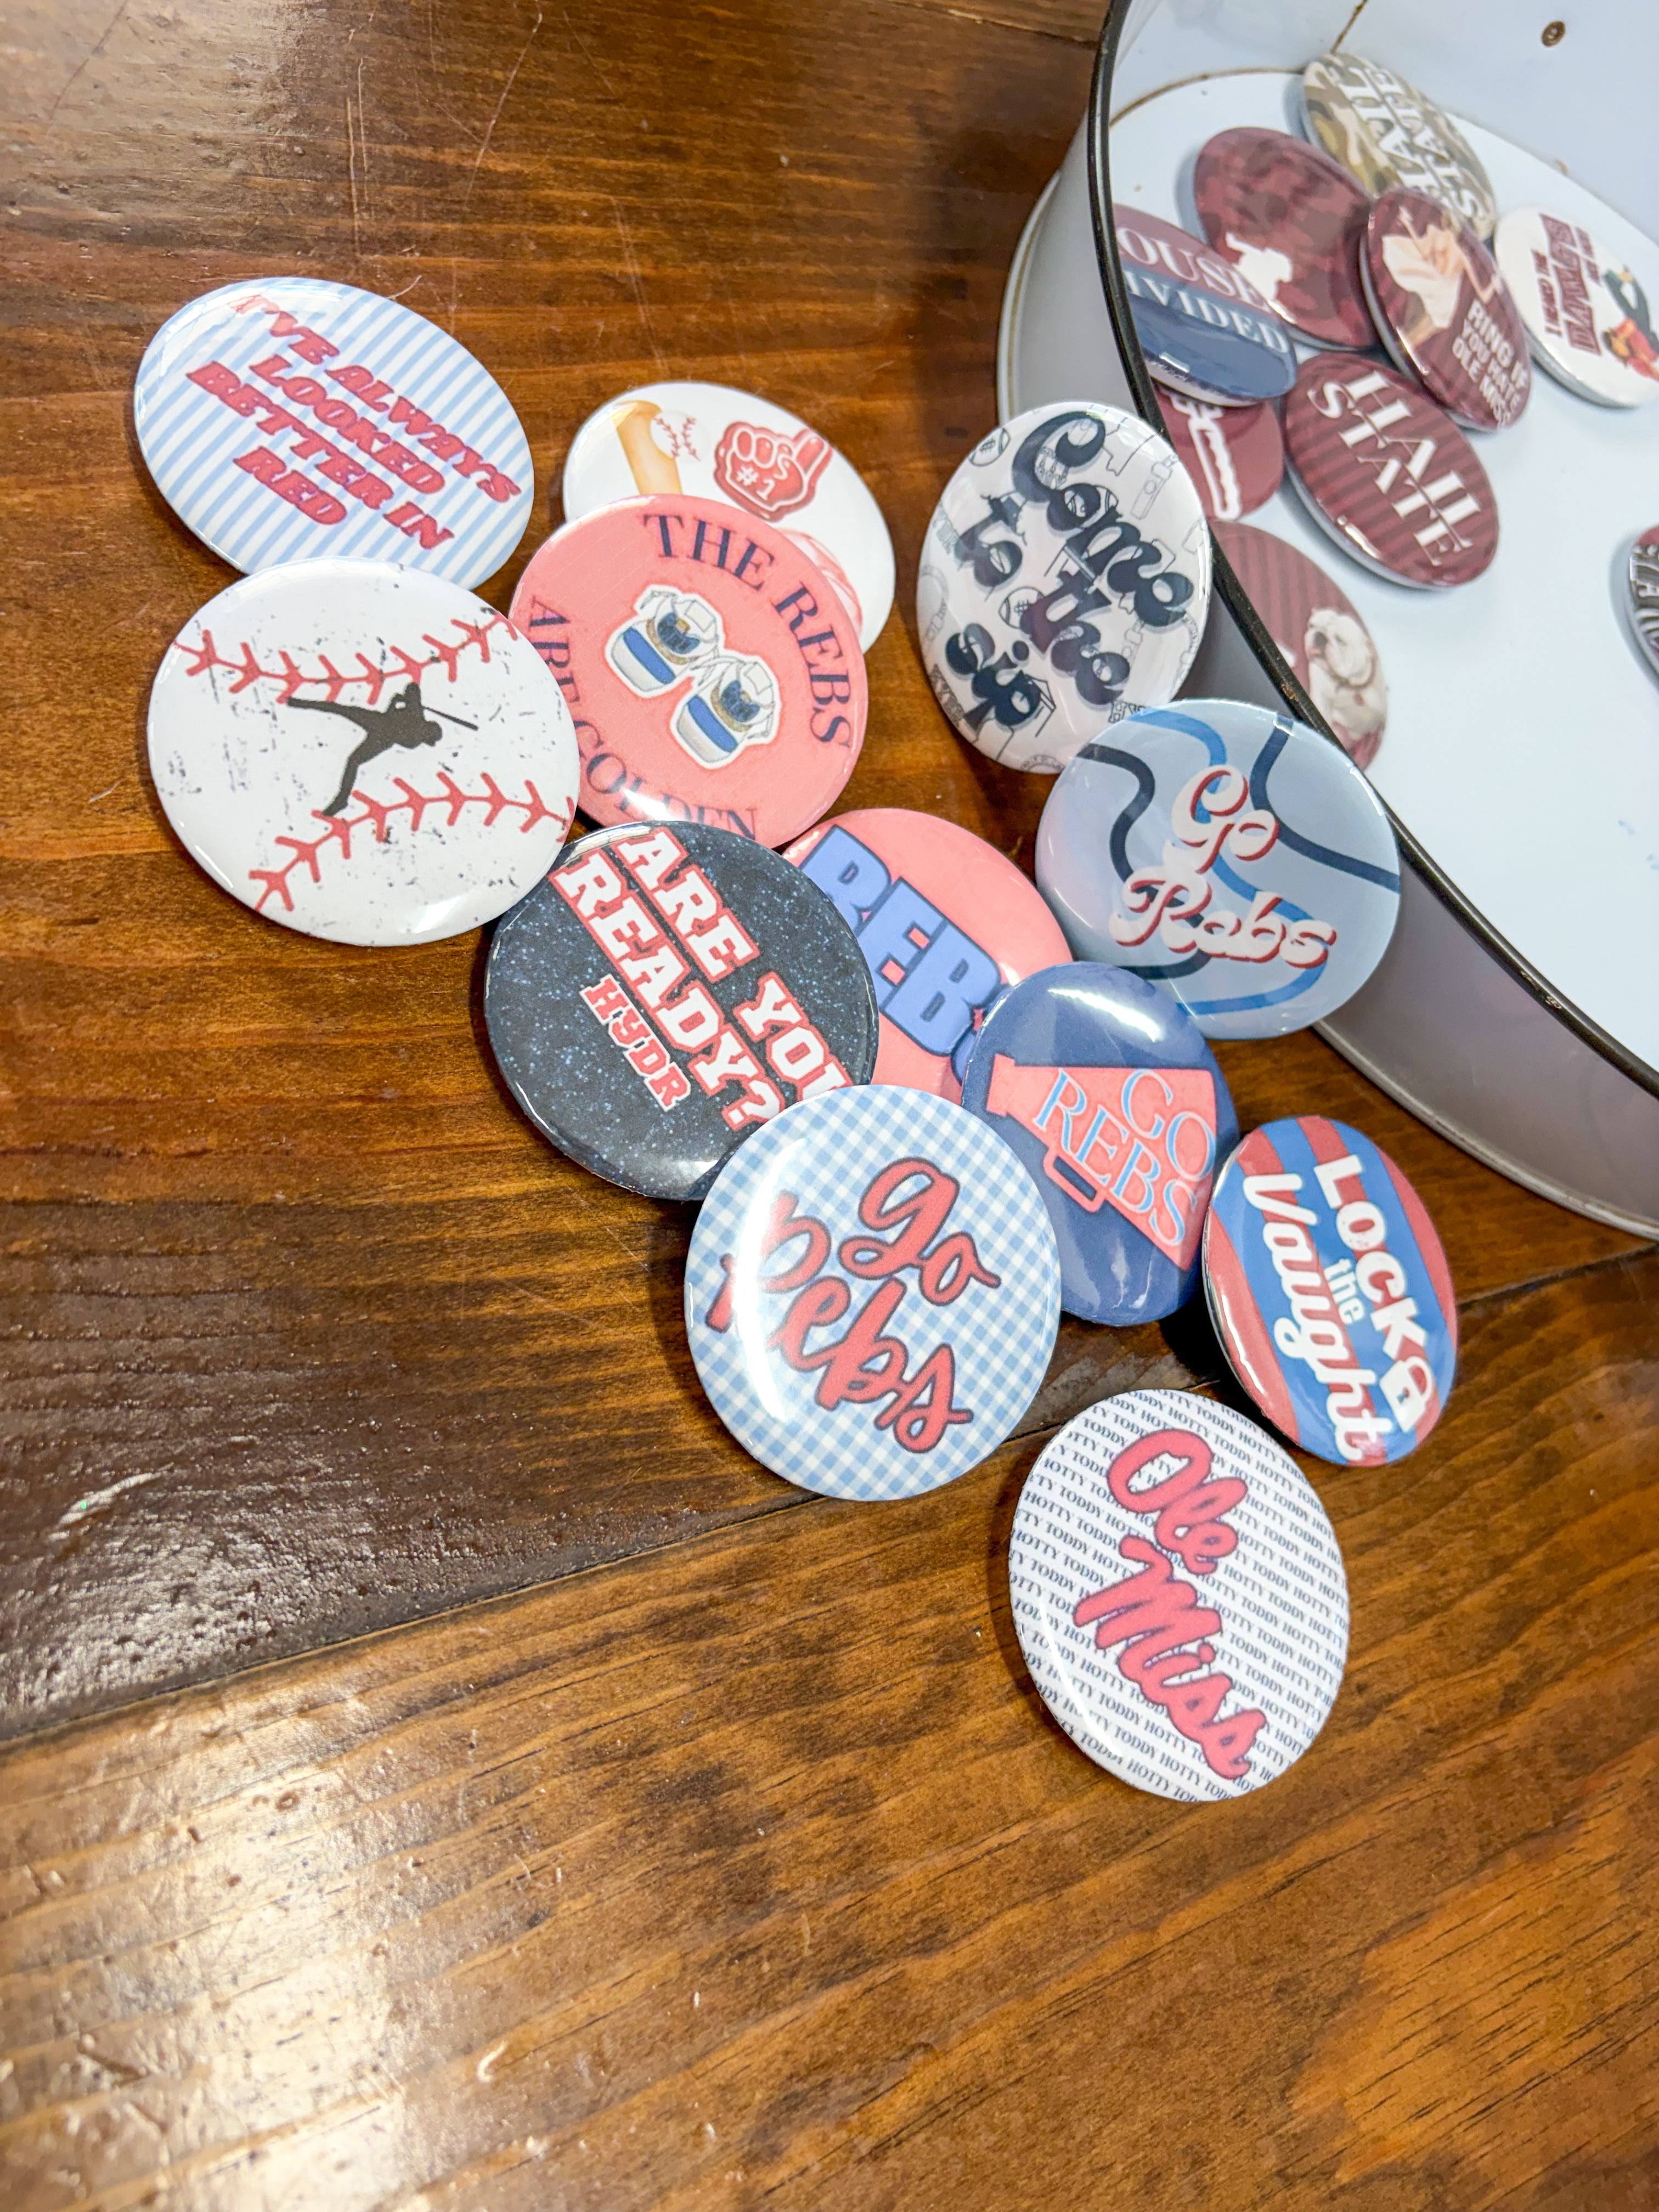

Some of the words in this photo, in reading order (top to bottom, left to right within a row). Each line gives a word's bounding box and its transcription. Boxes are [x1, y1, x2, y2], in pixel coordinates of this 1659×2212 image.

[1116, 227, 1272, 313] OUSE
[1123, 270, 1289, 353] IVIDED
[1462, 319, 1491, 363] YOU
[1468, 299, 1515, 368] RING
[250, 354, 445, 494] LOOKED
[1452, 337, 1482, 382] OLE
[185, 360, 394, 510] BETTER
[384, 501, 454, 549] IN
[233, 446, 347, 525] RED
[326, 365, 521, 503] ALWAYS
[1306, 381, 1463, 567] STATE
[1344, 370, 1482, 549] HAIL
[1012, 410, 1194, 628] Come
[643, 514, 776, 593] THE
[774, 580, 853, 749] REBS
[1162, 764, 1279, 874] Go
[616, 826, 760, 983] ARE
[799, 824, 1011, 1085] REB
[1109, 865, 1337, 969] Rebs
[549, 849, 785, 1132] READY?
[579, 974, 691, 1112] HYDR
[1032, 1067, 1198, 1246] REBS
[1121, 1068, 1217, 1181] GO
[837, 1156, 1001, 1307] go
[1313, 1154, 1426, 1361] LOCK
[1323, 1257, 1365, 1325] the
[1242, 1173, 1393, 1461] Vaught
[1107, 1427, 1249, 1575] Ole
[1073, 1534, 1267, 1780] Miss
